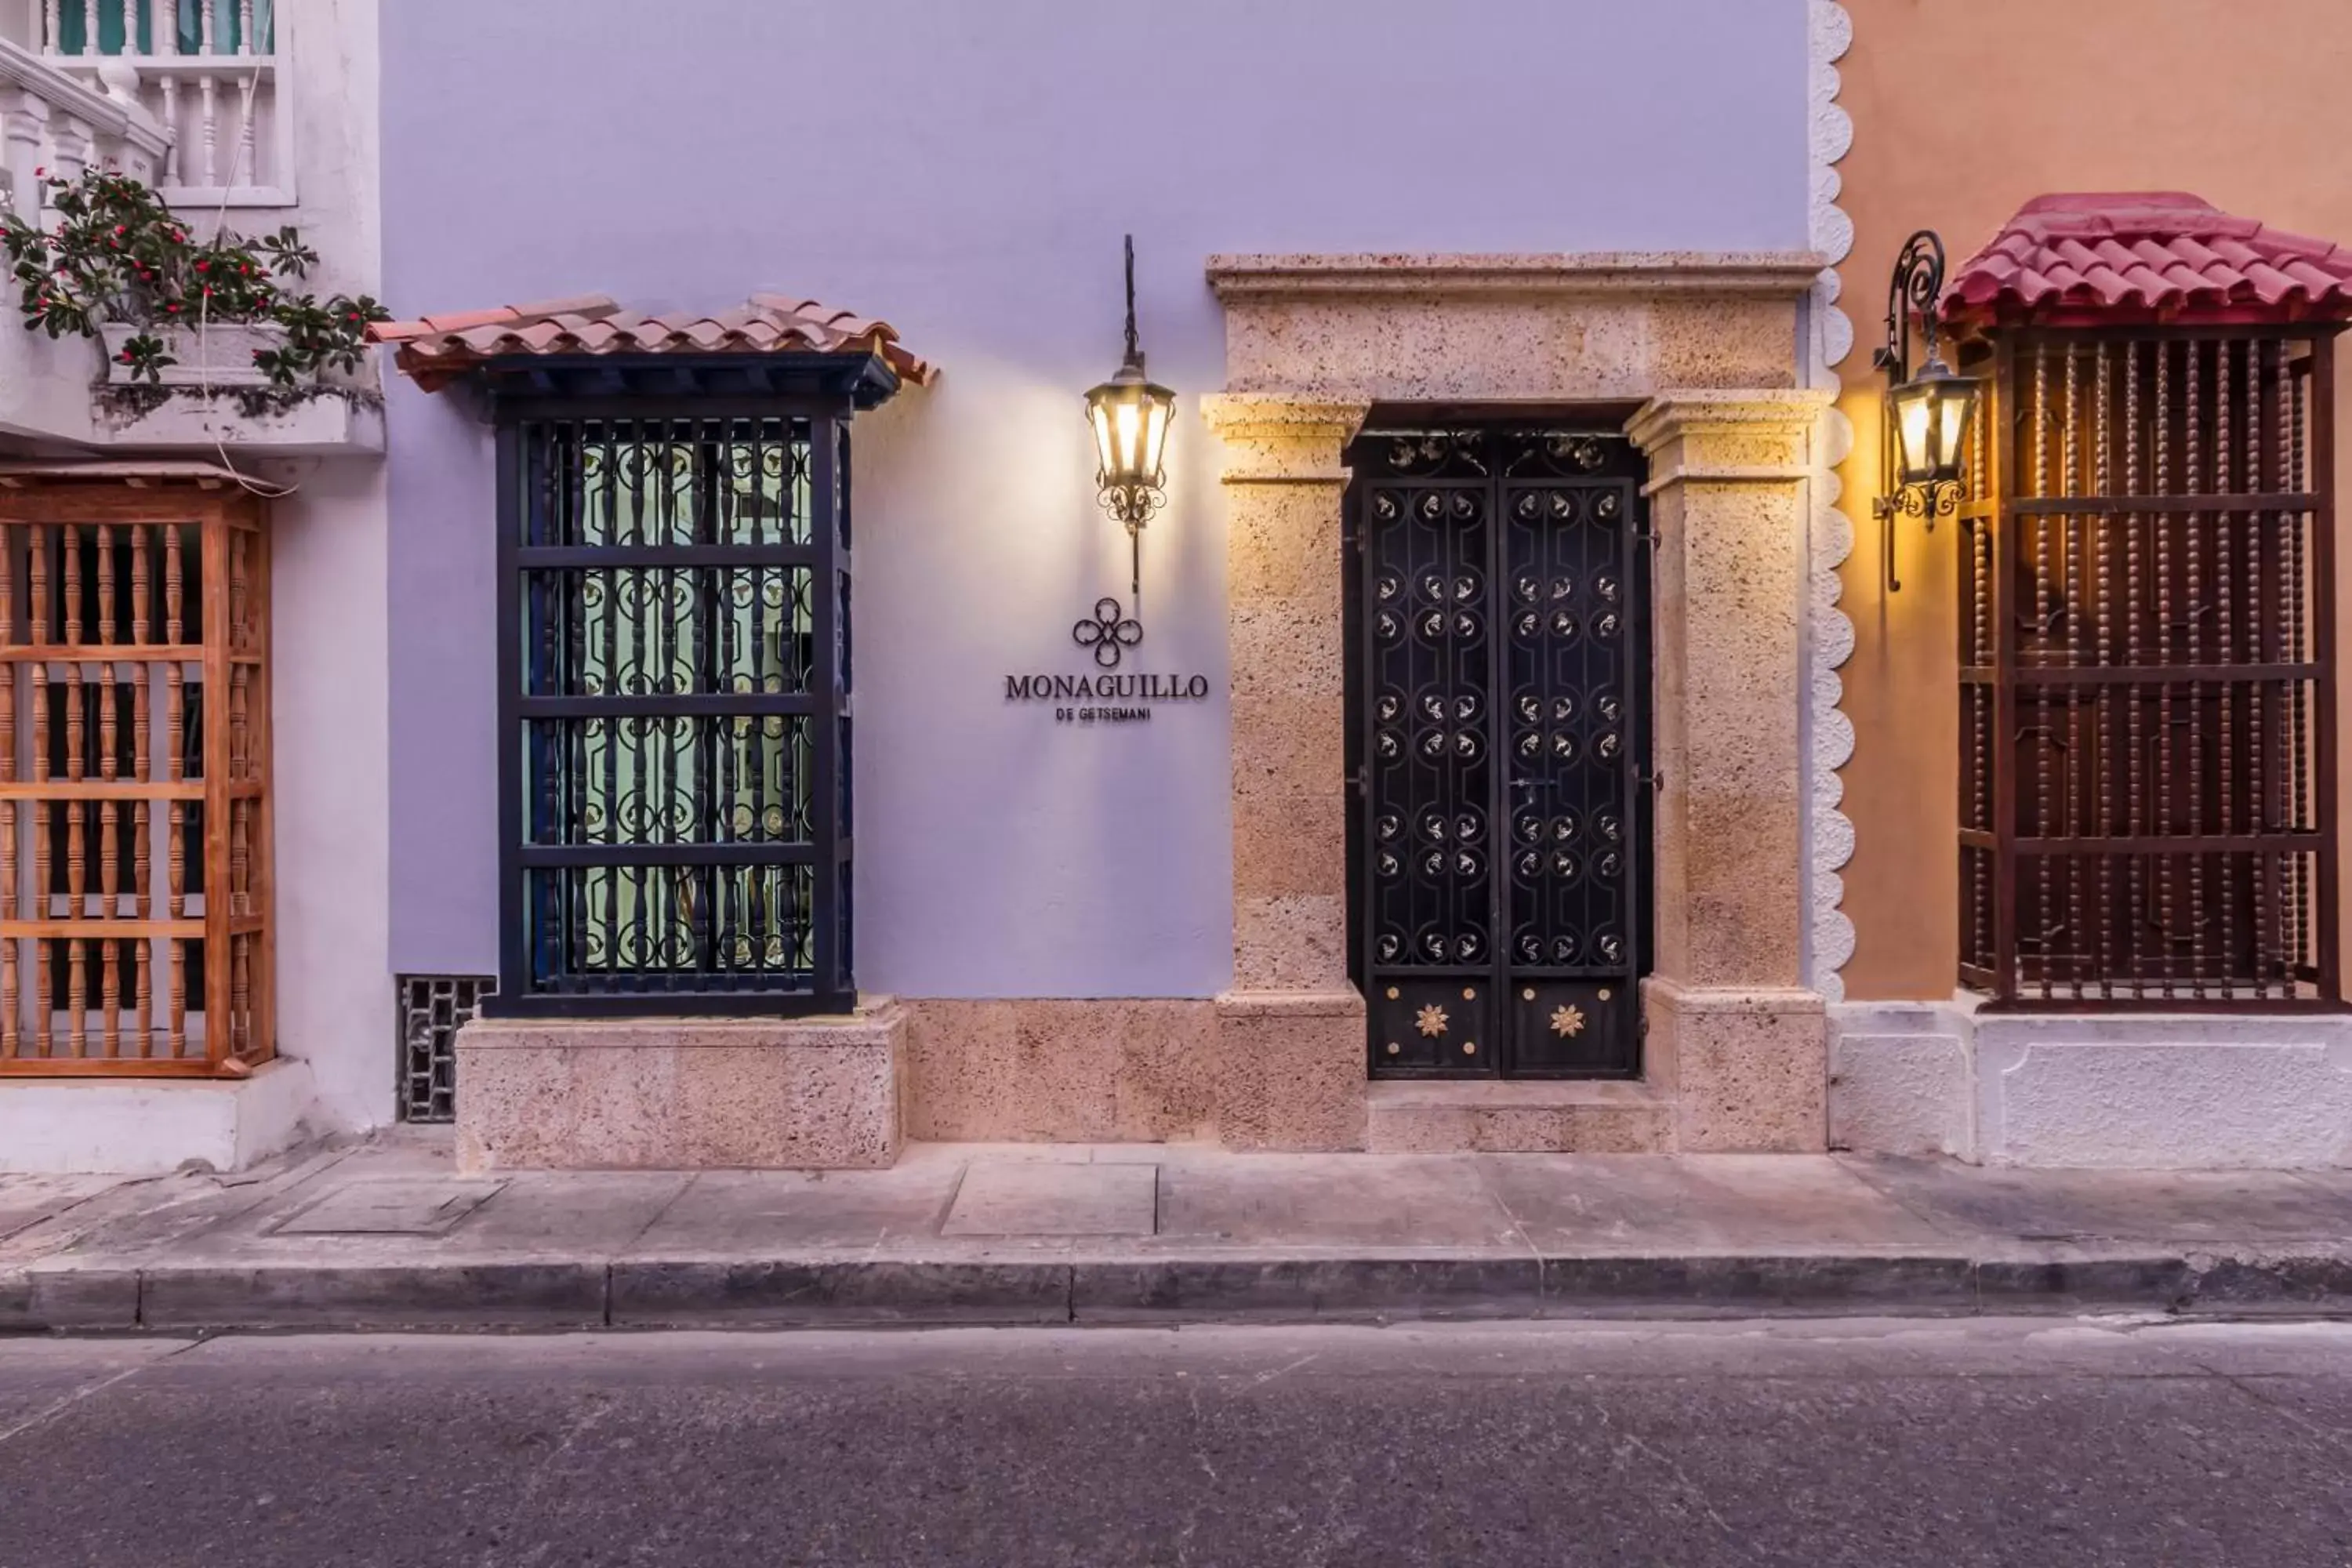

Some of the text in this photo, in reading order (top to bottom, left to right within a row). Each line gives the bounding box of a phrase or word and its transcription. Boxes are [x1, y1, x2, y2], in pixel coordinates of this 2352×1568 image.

[1005, 673, 1208, 699] MONAGUILLO
[1056, 707, 1151, 721] DE GETSEMANI
